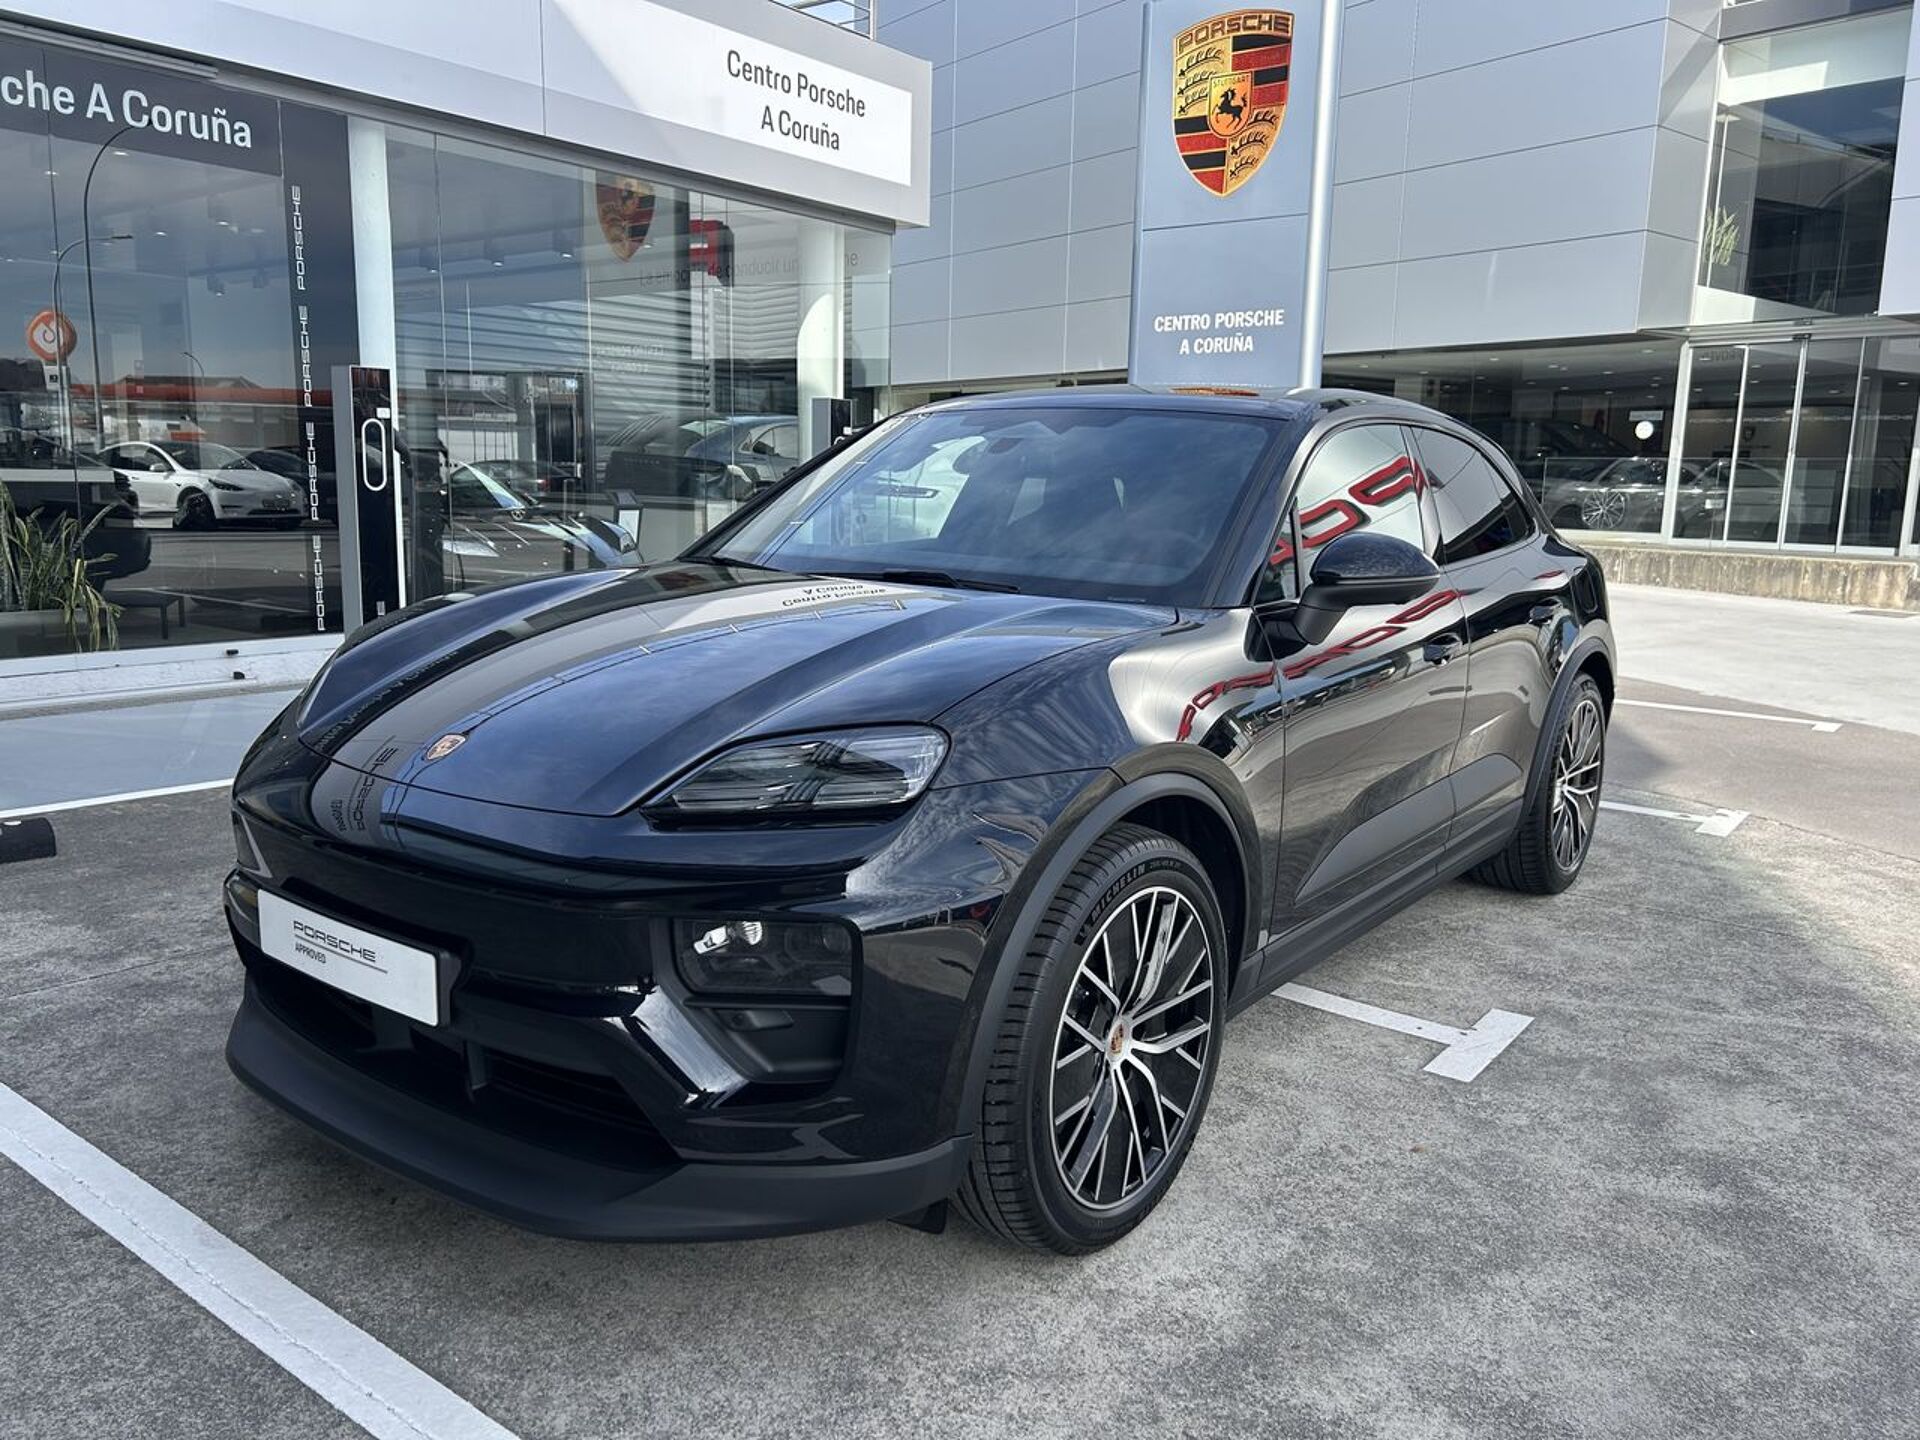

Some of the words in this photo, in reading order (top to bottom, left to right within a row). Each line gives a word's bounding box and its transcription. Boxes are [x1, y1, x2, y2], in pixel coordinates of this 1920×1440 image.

[1178, 14, 1290, 54] PORSCHE
[0, 70, 75, 115] che
[86, 82, 115, 123] A
[122, 89, 252, 148] Coruña
[726, 49, 792, 95] Centro
[797, 72, 866, 118] Porsche
[760, 104, 775, 133] A
[778, 109, 840, 151] Coruña
[291, 185, 306, 291] PORSCHE
[1154, 314, 1211, 332] CENTRO
[1215, 309, 1285, 329] PORSCHE
[1179, 338, 1191, 355] A
[1193, 332, 1254, 354] CORUÑA
[298, 305, 312, 408] PORSCHE
[305, 421, 320, 521] PORSCHE
[312, 534, 326, 631] PORSCHE
[1090, 862, 1147, 923] MICHELIN
[293, 920, 376, 963] PORSCHE
[294, 942, 327, 964] APPROVED
